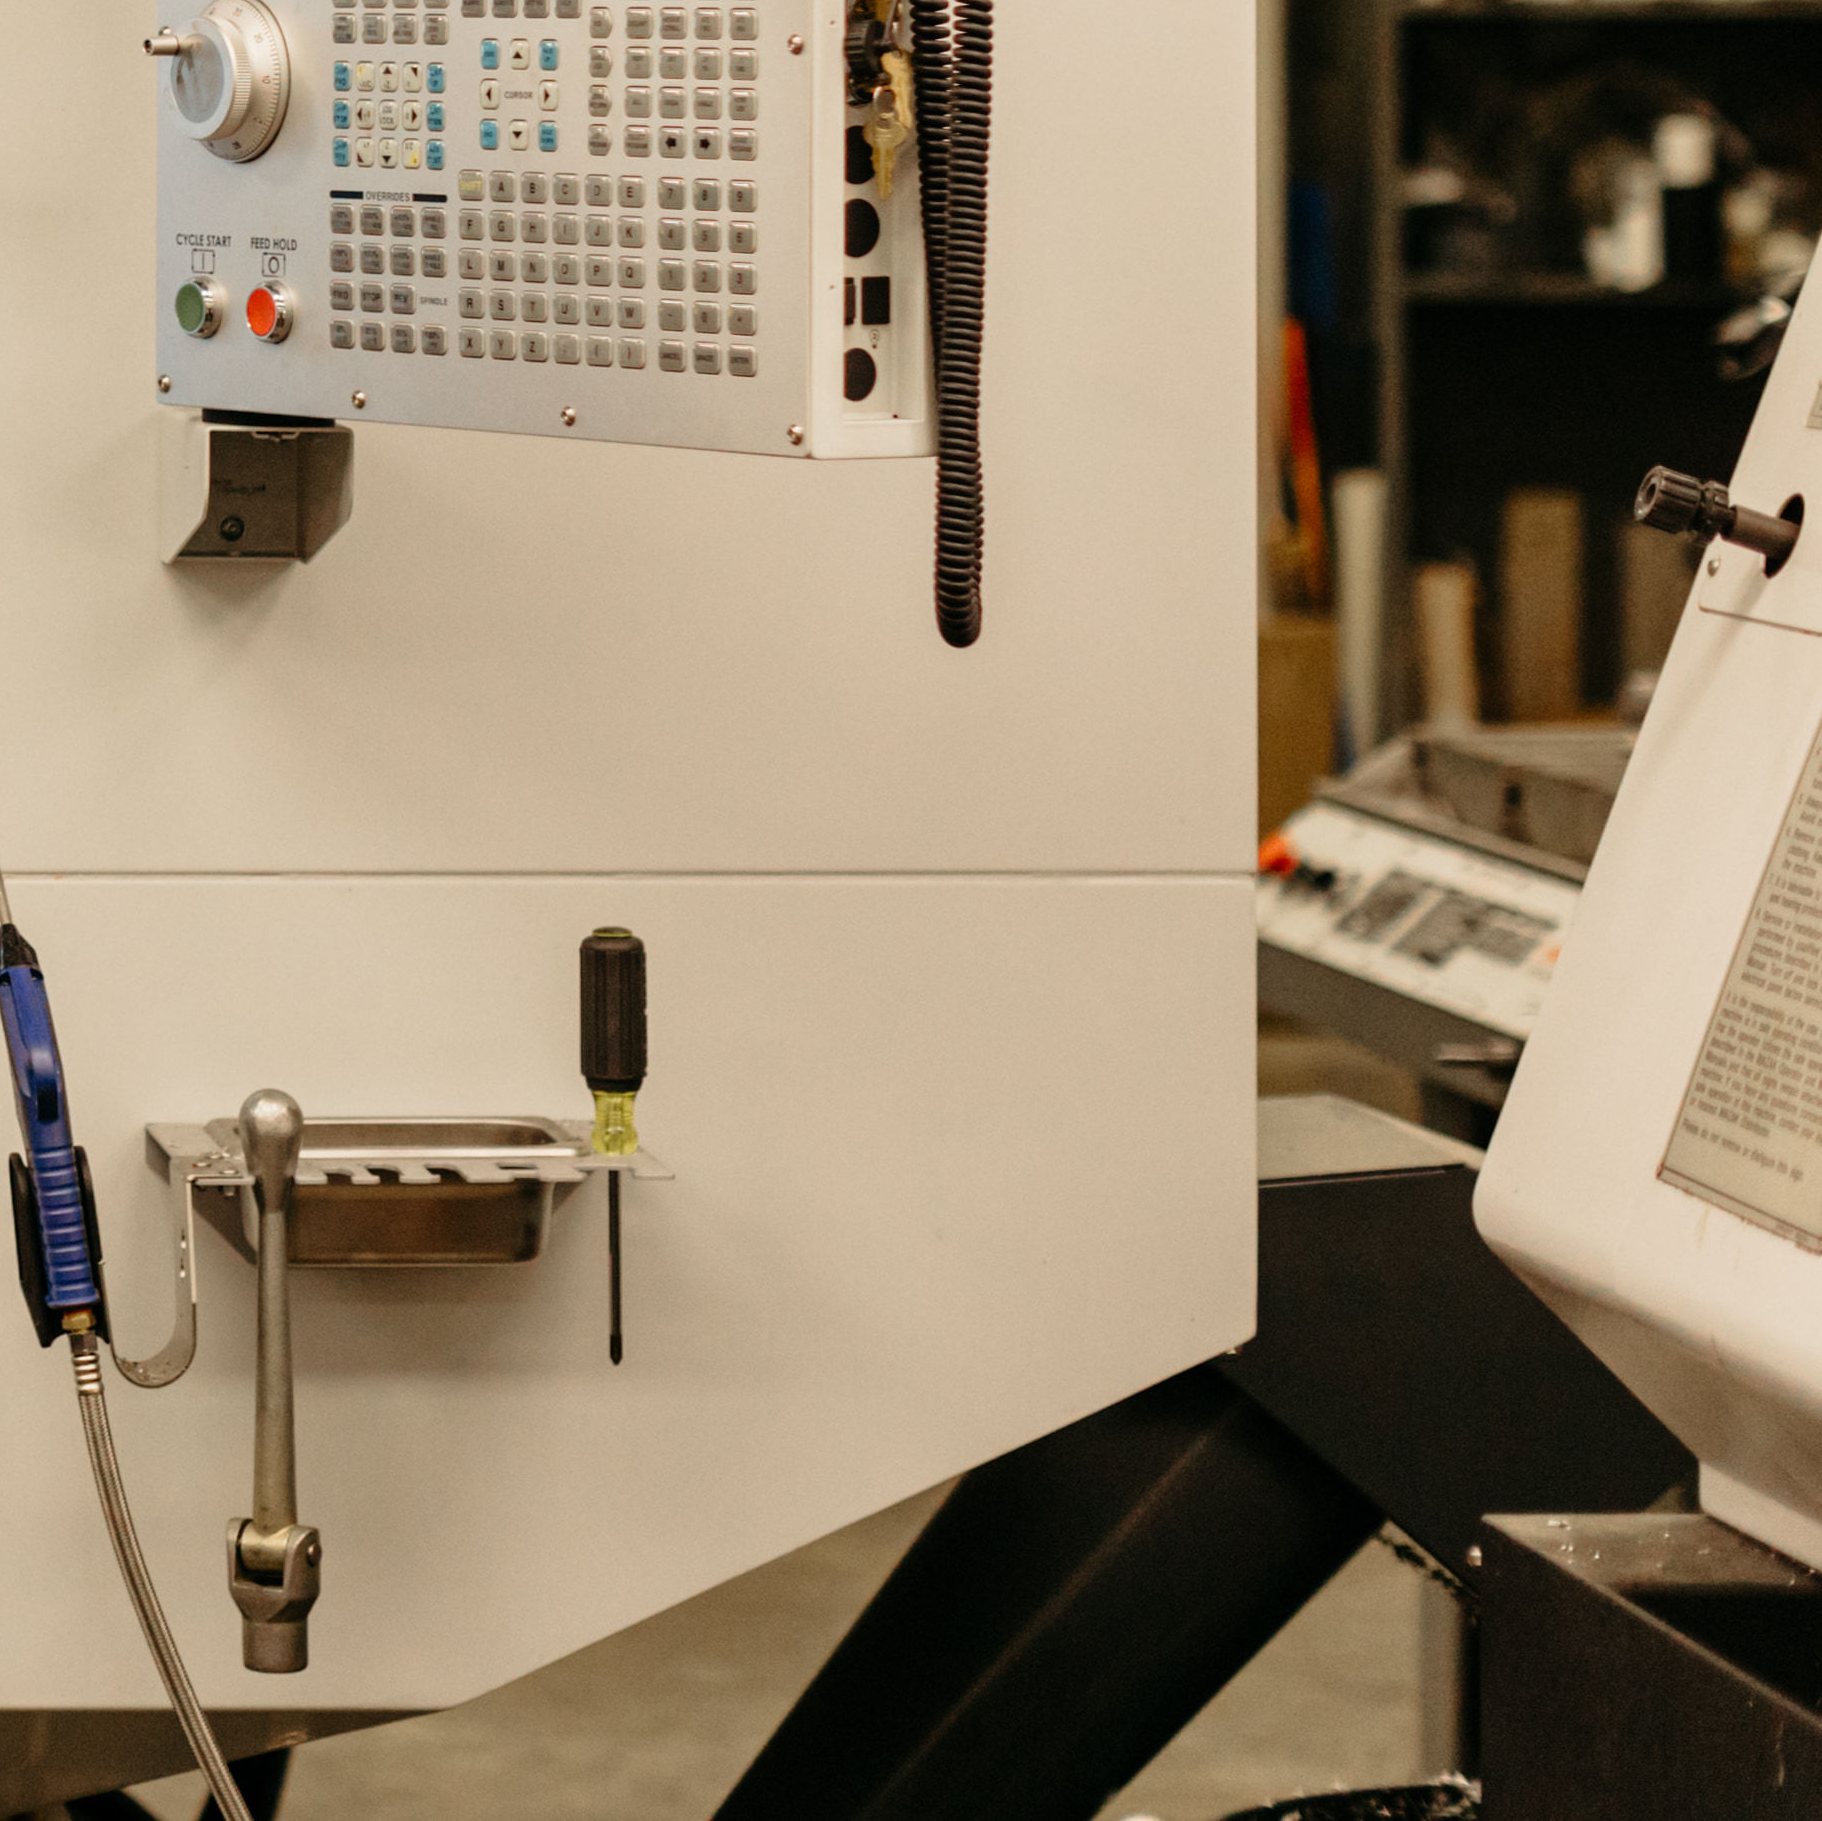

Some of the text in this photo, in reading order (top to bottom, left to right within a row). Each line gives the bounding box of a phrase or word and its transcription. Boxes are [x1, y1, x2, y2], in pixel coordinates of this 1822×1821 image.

[504, 90, 533, 100] CURSOR
[498, 182, 505, 193] A
[561, 183, 569, 195] C
[593, 185, 601, 196] D
[626, 186, 633, 198] E
[365, 190, 411, 203] OVERRIDES
[467, 219, 473, 230] F
[497, 220, 505, 233] G
[529, 221, 536, 233] H
[594, 225, 600, 237] J
[625, 226, 633, 239] K
[176, 234, 232, 247] CYCLE START
[250, 237, 297, 251] FEED HOLD
[467, 258, 473, 270] L
[497, 260, 505, 271] M
[529, 262, 536, 273] N
[593, 265, 600, 276] P
[625, 266, 634, 279] Q
[362, 292, 381, 302] STOP
[420, 296, 448, 307] SPINDLE
[466, 297, 473, 308] R
[498, 299, 505, 311] S
[529, 301, 536, 313] T
[561, 303, 569, 315] U
[593, 305, 600, 316] V
[625, 307, 634, 318] W
[466, 337, 473, 349] X
[497, 339, 504, 350] Y
[529, 340, 536, 353] Z
